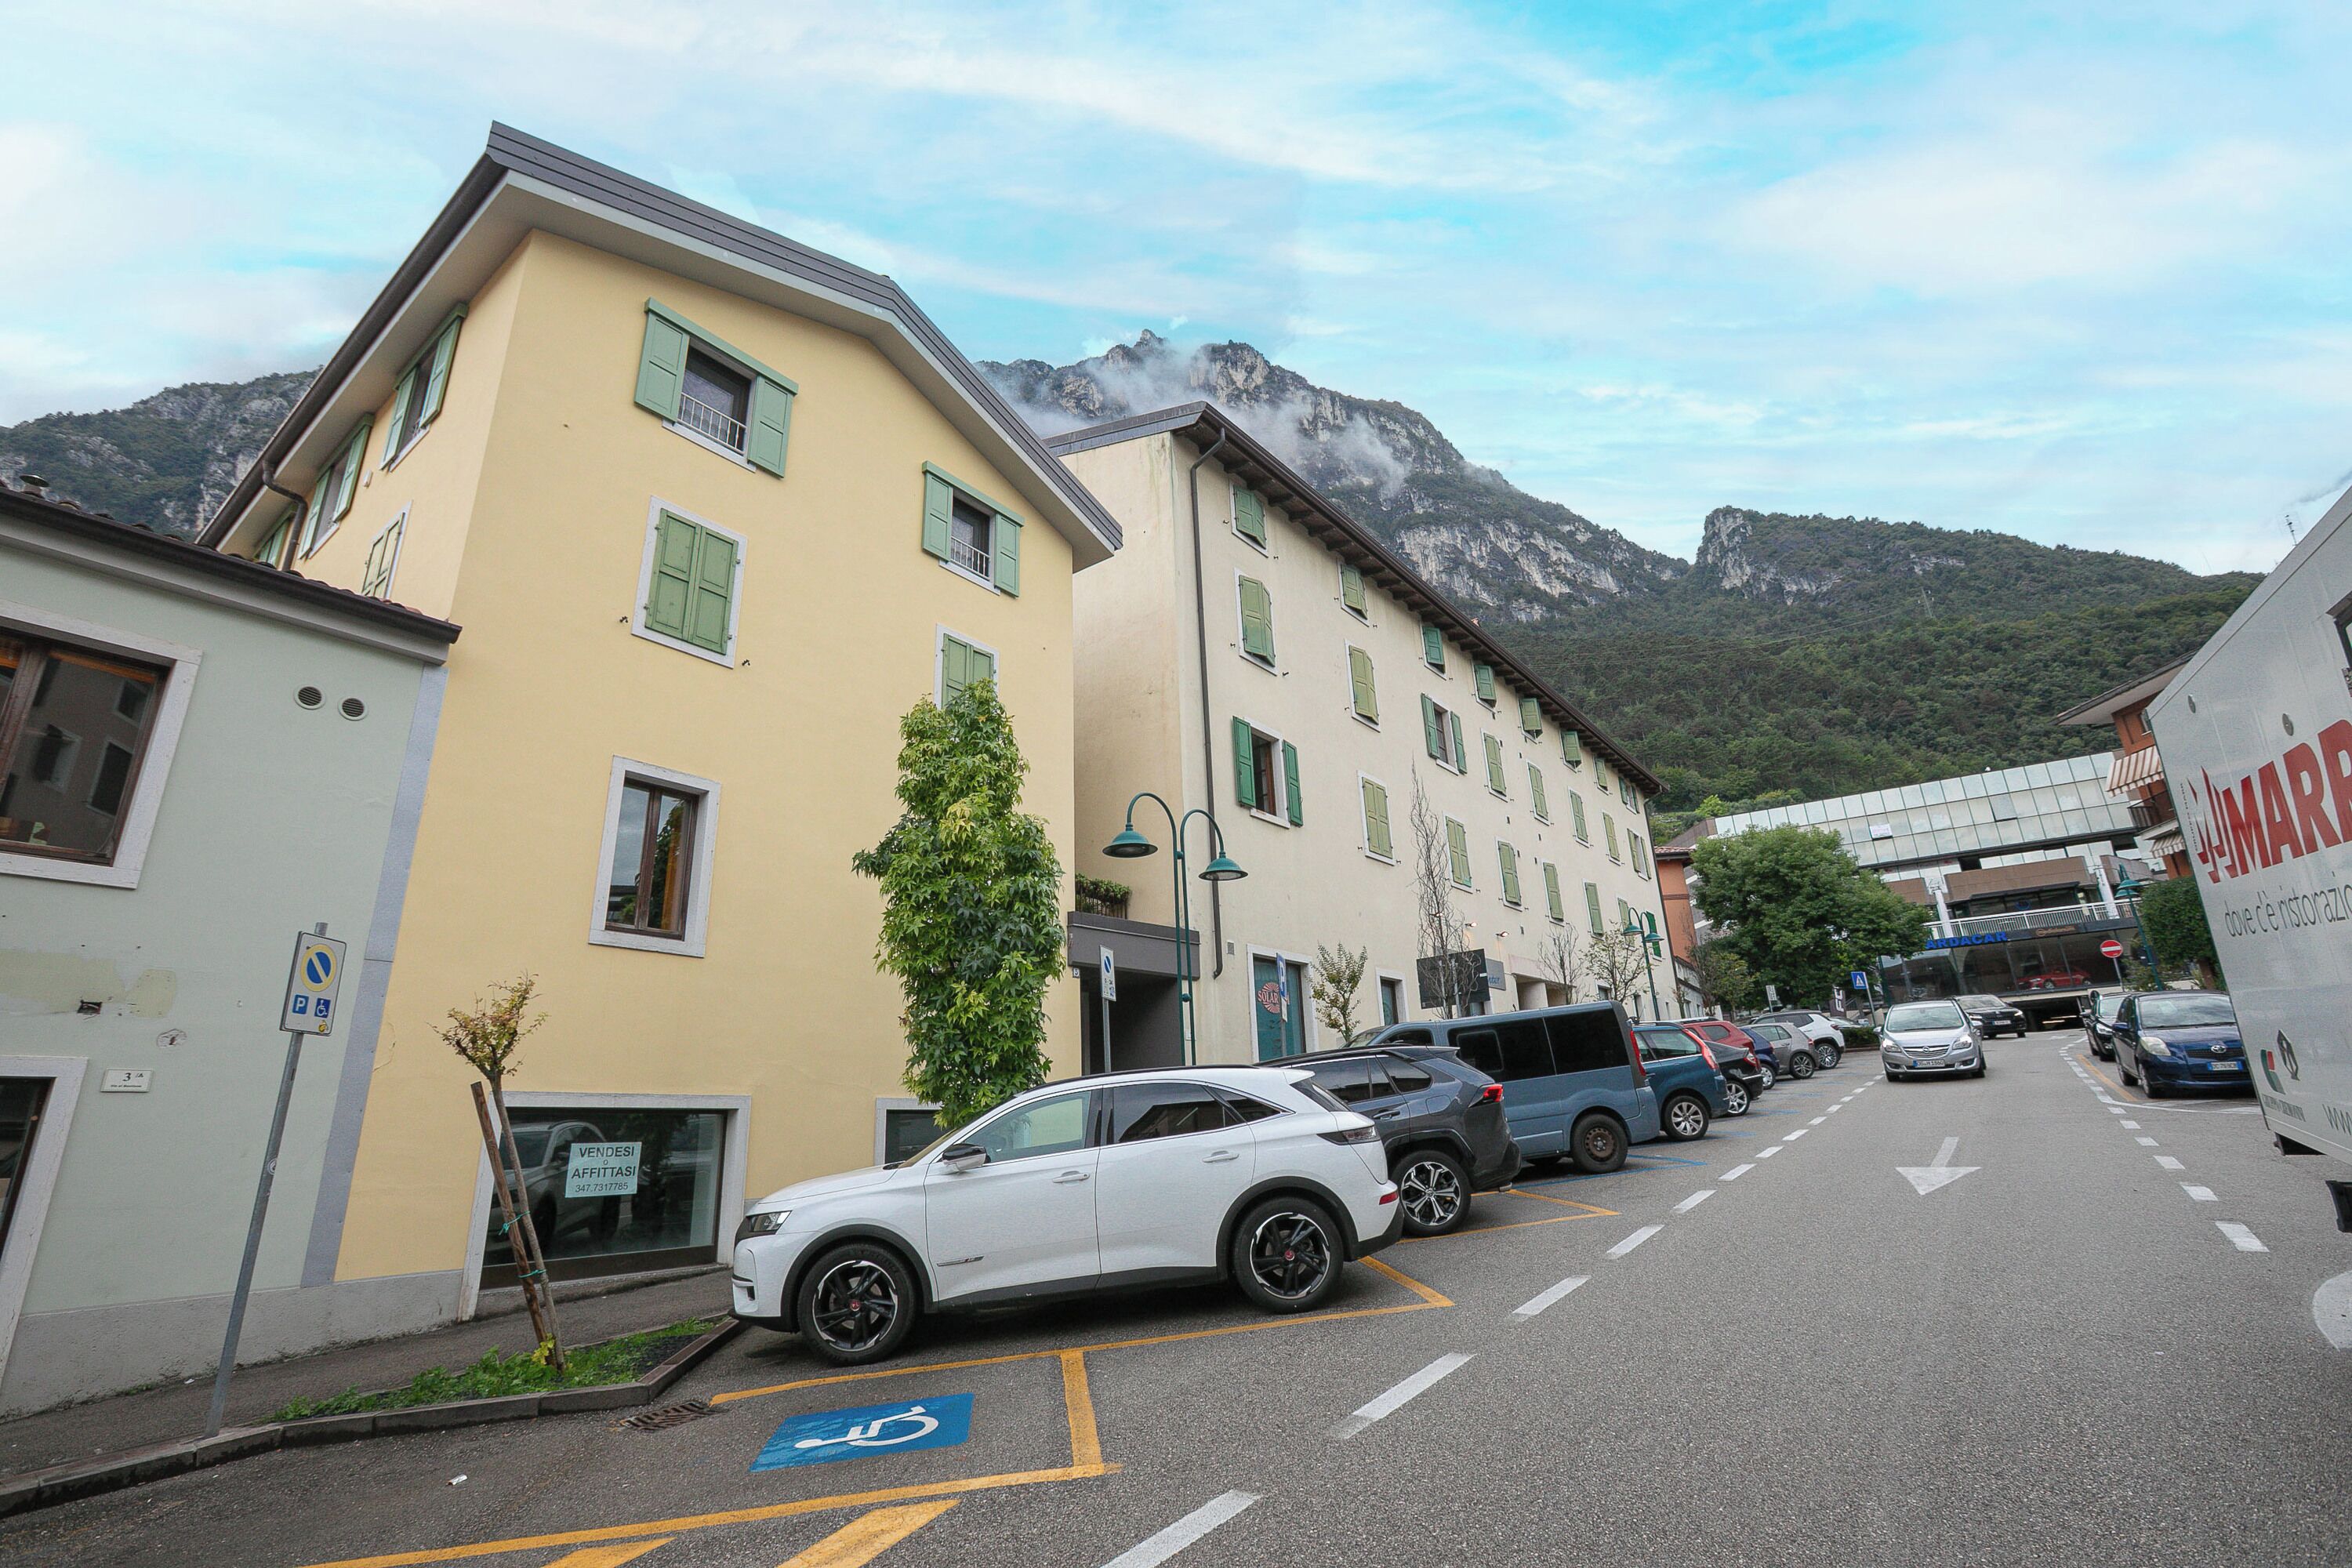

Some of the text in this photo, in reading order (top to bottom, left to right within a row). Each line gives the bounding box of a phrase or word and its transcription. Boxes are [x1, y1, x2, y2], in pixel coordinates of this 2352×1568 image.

[2224, 900, 2256, 937] dove
[295, 997, 306, 1011] P
[122, 1073, 132, 1081] 3
[579, 1146, 635, 1158] VENDESI
[572, 1166, 636, 1179] AFFITTASI
[575, 1182, 628, 1192] 347.7317785
